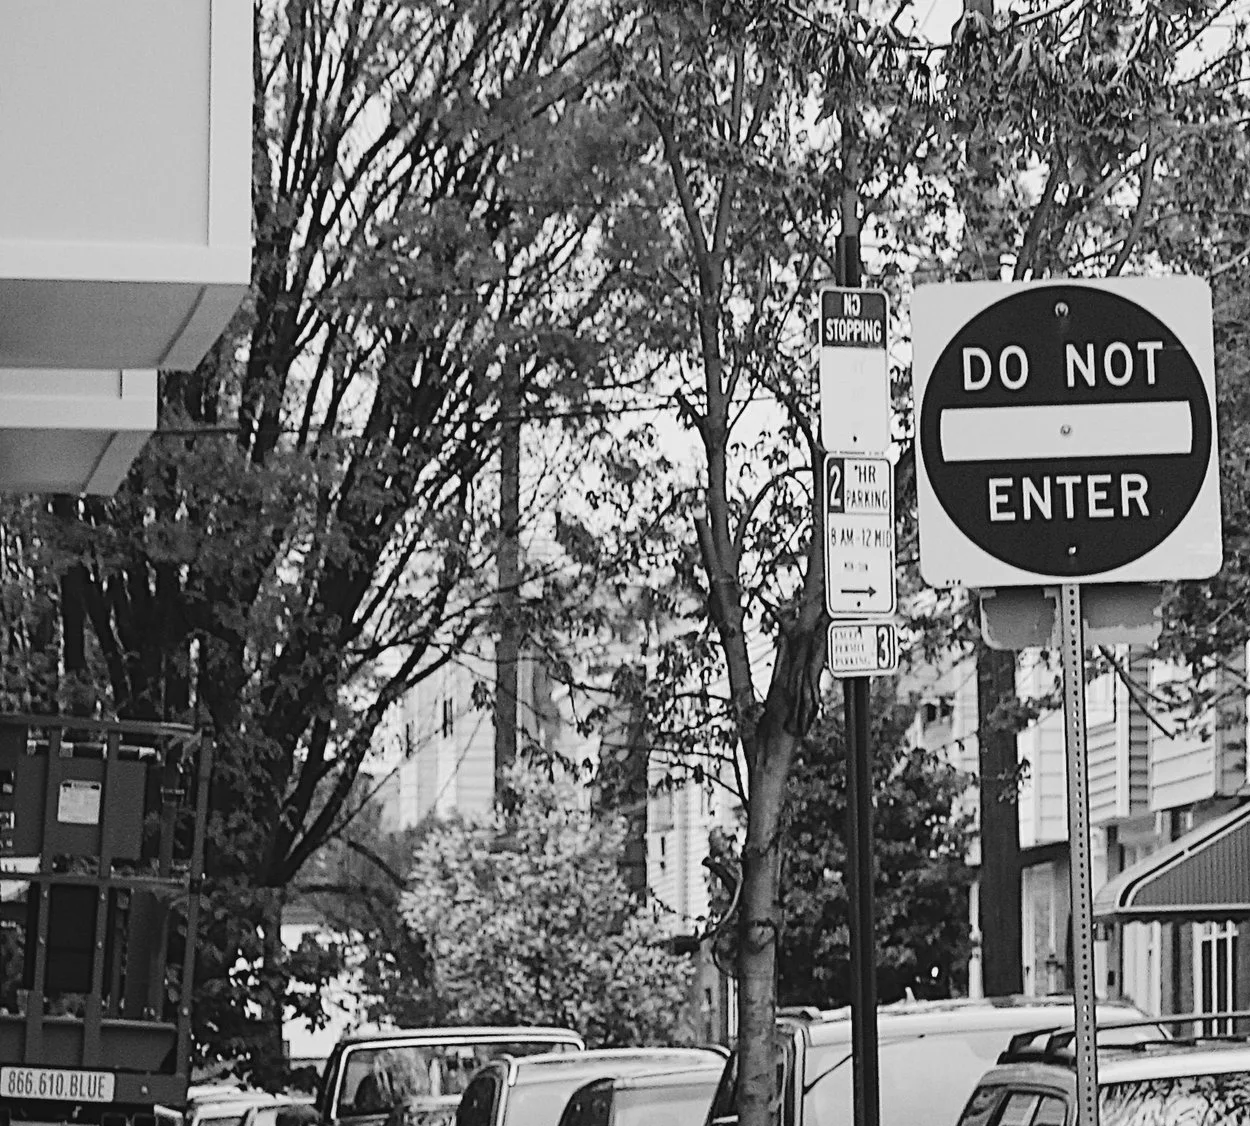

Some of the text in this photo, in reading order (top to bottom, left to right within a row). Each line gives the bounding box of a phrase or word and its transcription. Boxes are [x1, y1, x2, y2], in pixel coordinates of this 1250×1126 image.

[843, 293, 861, 317] NO
[826, 317, 882, 343] STOPPING
[962, 340, 1164, 391] DO NOT
[829, 463, 876, 507] 2 HR
[846, 489, 888, 509] PARKING
[988, 473, 1151, 522] ENTER
[831, 527, 837, 548] 8
[840, 528, 855, 547] AM
[862, 527, 872, 547] 12
[877, 626, 890, 669] 3
[8, 1070, 106, 1099] 866.610.BLUE
